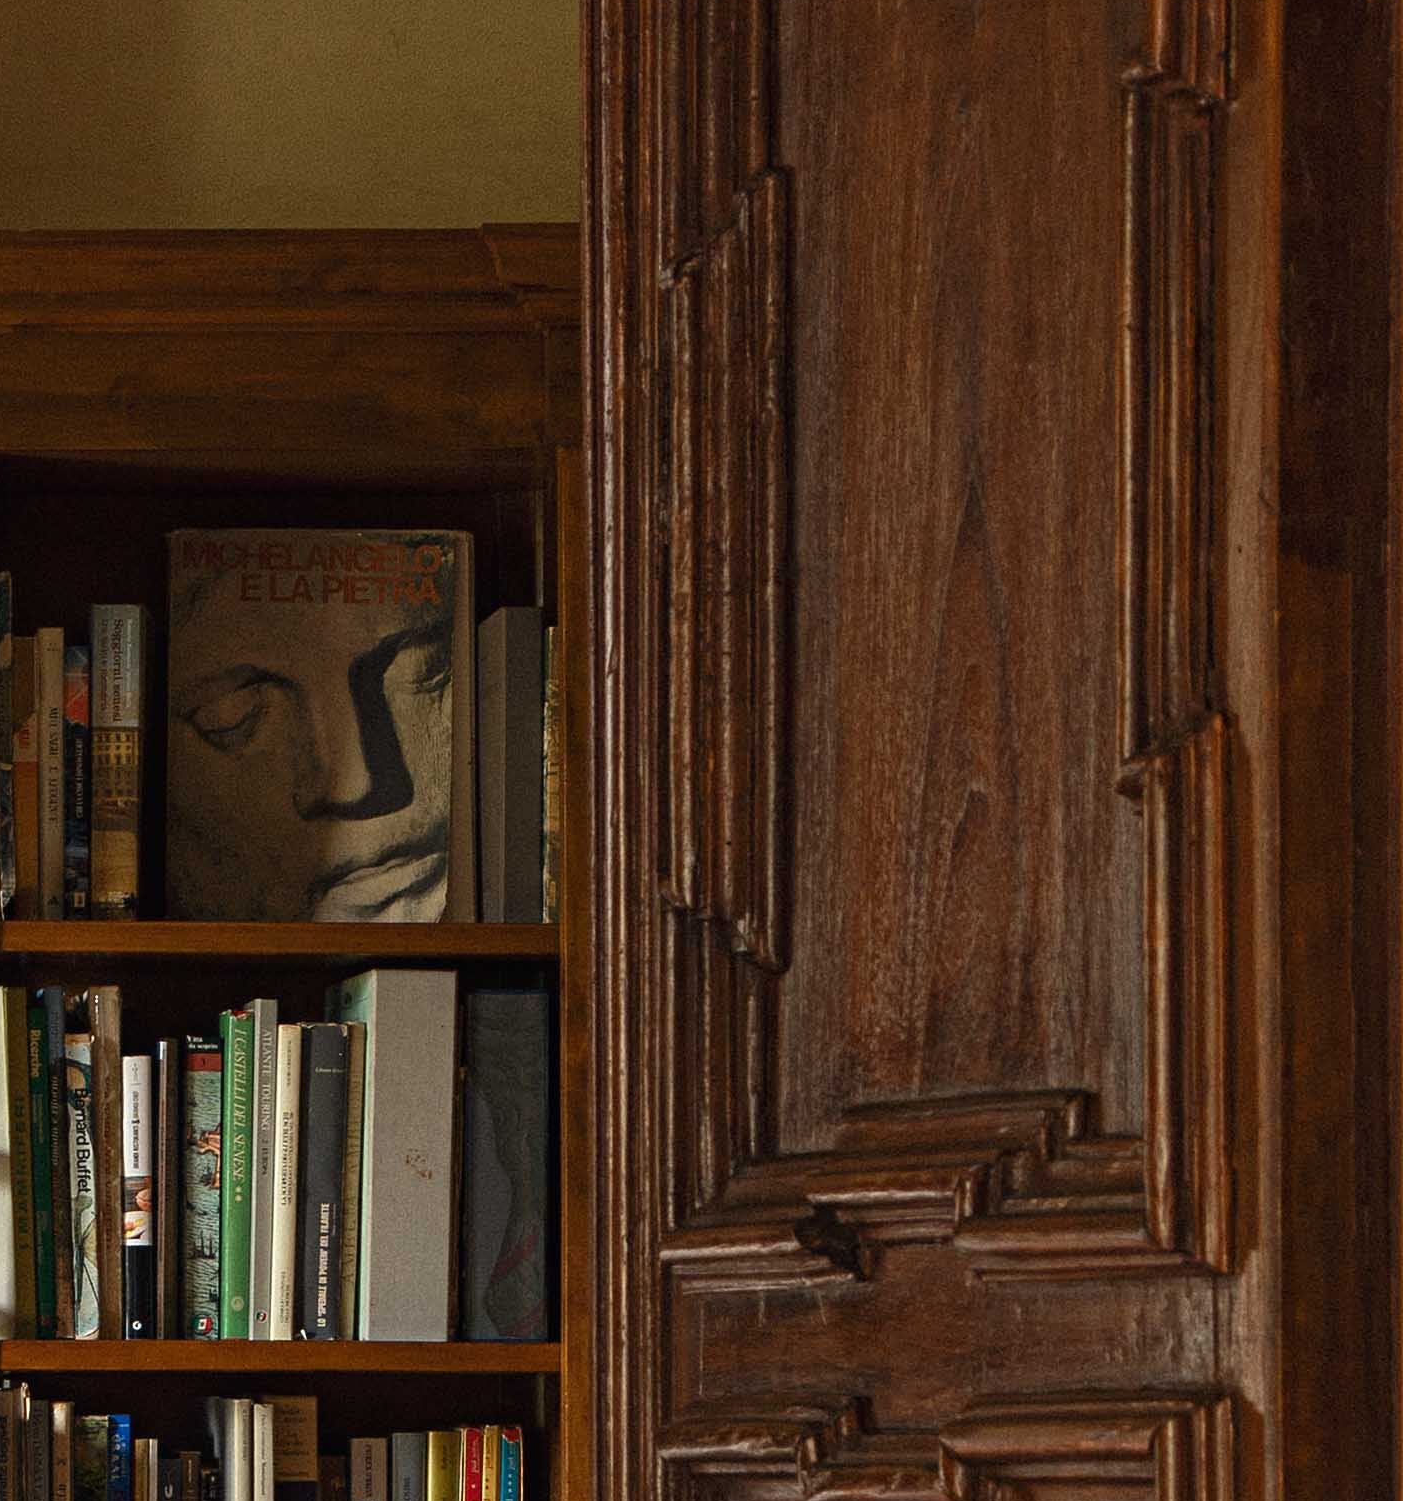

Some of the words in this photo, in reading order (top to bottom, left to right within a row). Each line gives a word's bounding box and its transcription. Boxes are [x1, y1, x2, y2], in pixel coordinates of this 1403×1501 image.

[182, 541, 442, 574] MICHELANGELO
[240, 573, 262, 603] E
[269, 573, 314, 604] LA
[322, 573, 441, 604] PIETRA
[232, 1037, 247, 1102] CASTELLI
[260, 1029, 272, 1076] ATLANTE
[74, 1088, 88, 1146] Bernard
[232, 1103, 246, 1129] DEL
[260, 1083, 271, 1131] TOURING
[76, 1149, 91, 1192] Buffet
[231, 1135, 246, 1181] SENESE
